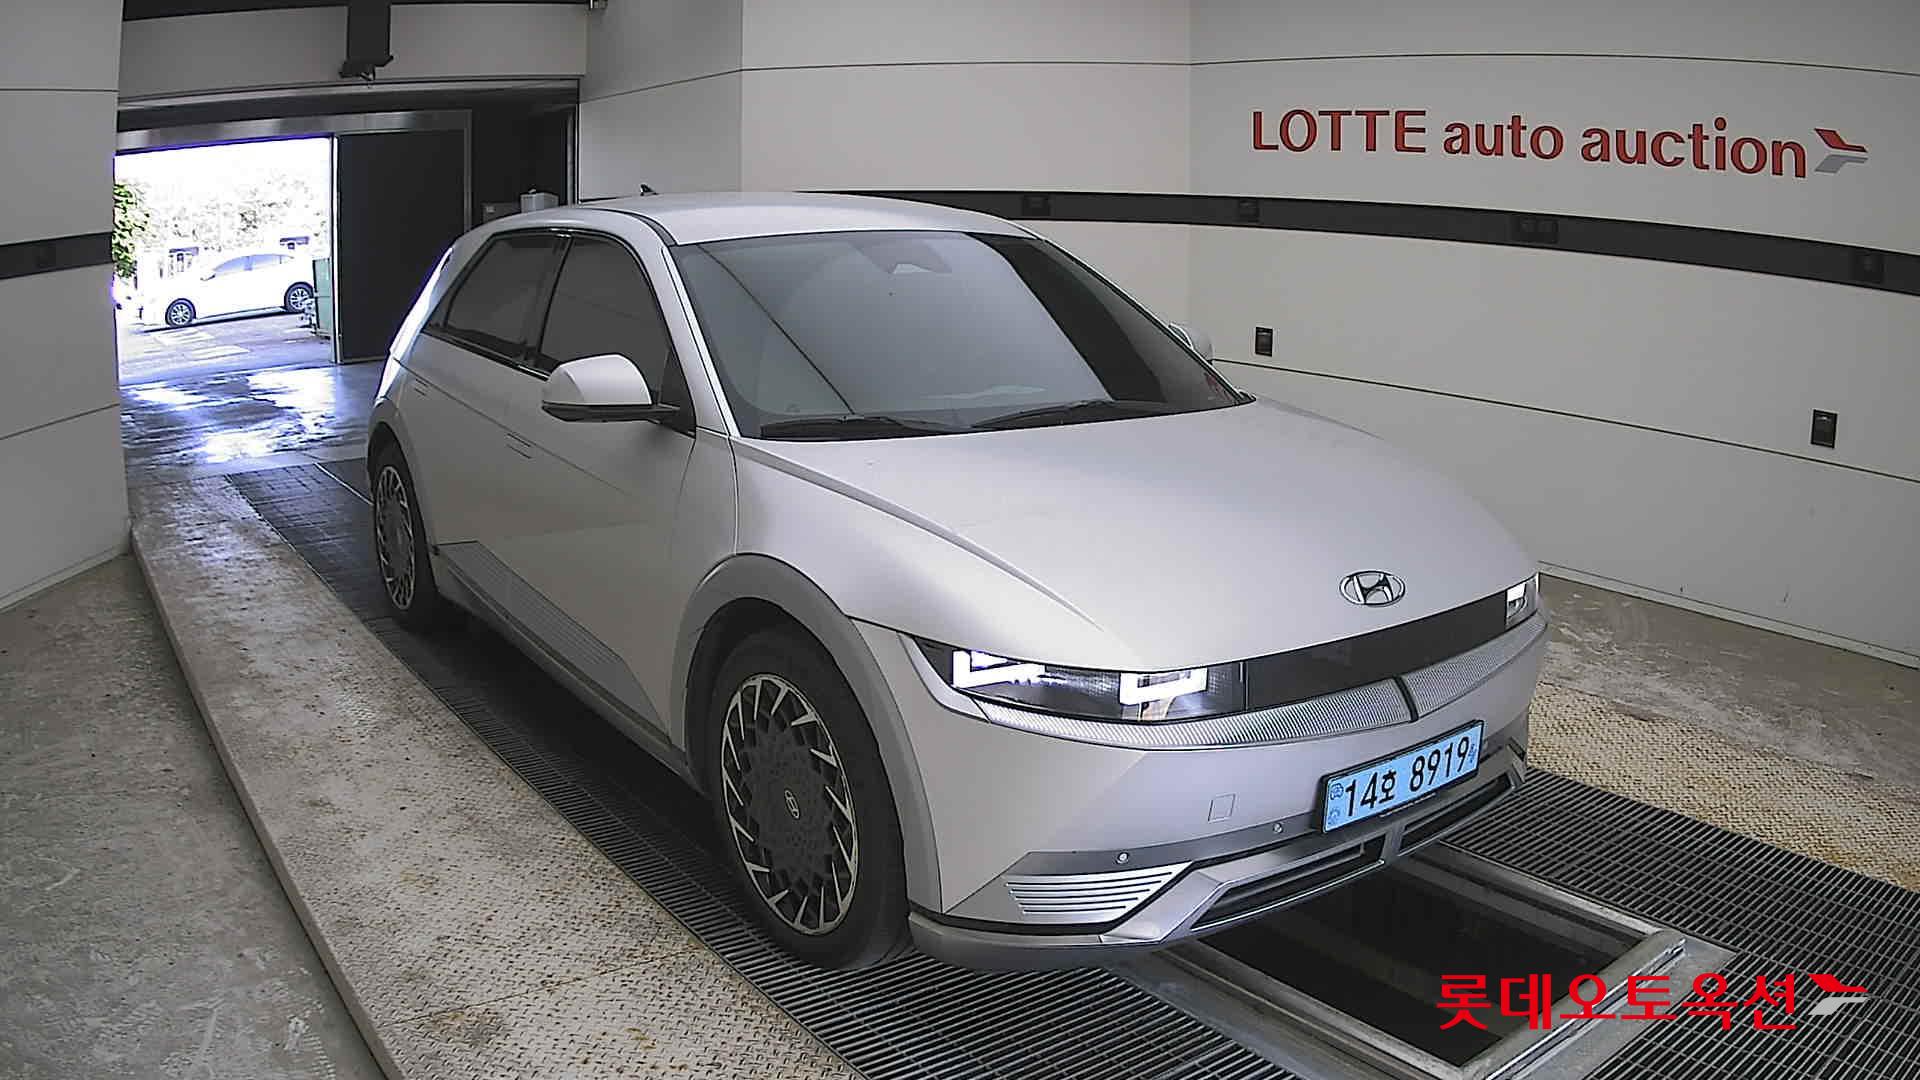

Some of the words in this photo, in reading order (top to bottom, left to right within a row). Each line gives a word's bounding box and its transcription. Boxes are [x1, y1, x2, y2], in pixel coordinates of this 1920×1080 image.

[1252, 109, 1427, 153] LOTTE
[1442, 114, 1565, 160] auto
[1581, 116, 1807, 179] auction
[1345, 769, 1397, 817] 14호
[1409, 736, 1470, 793] 8919
